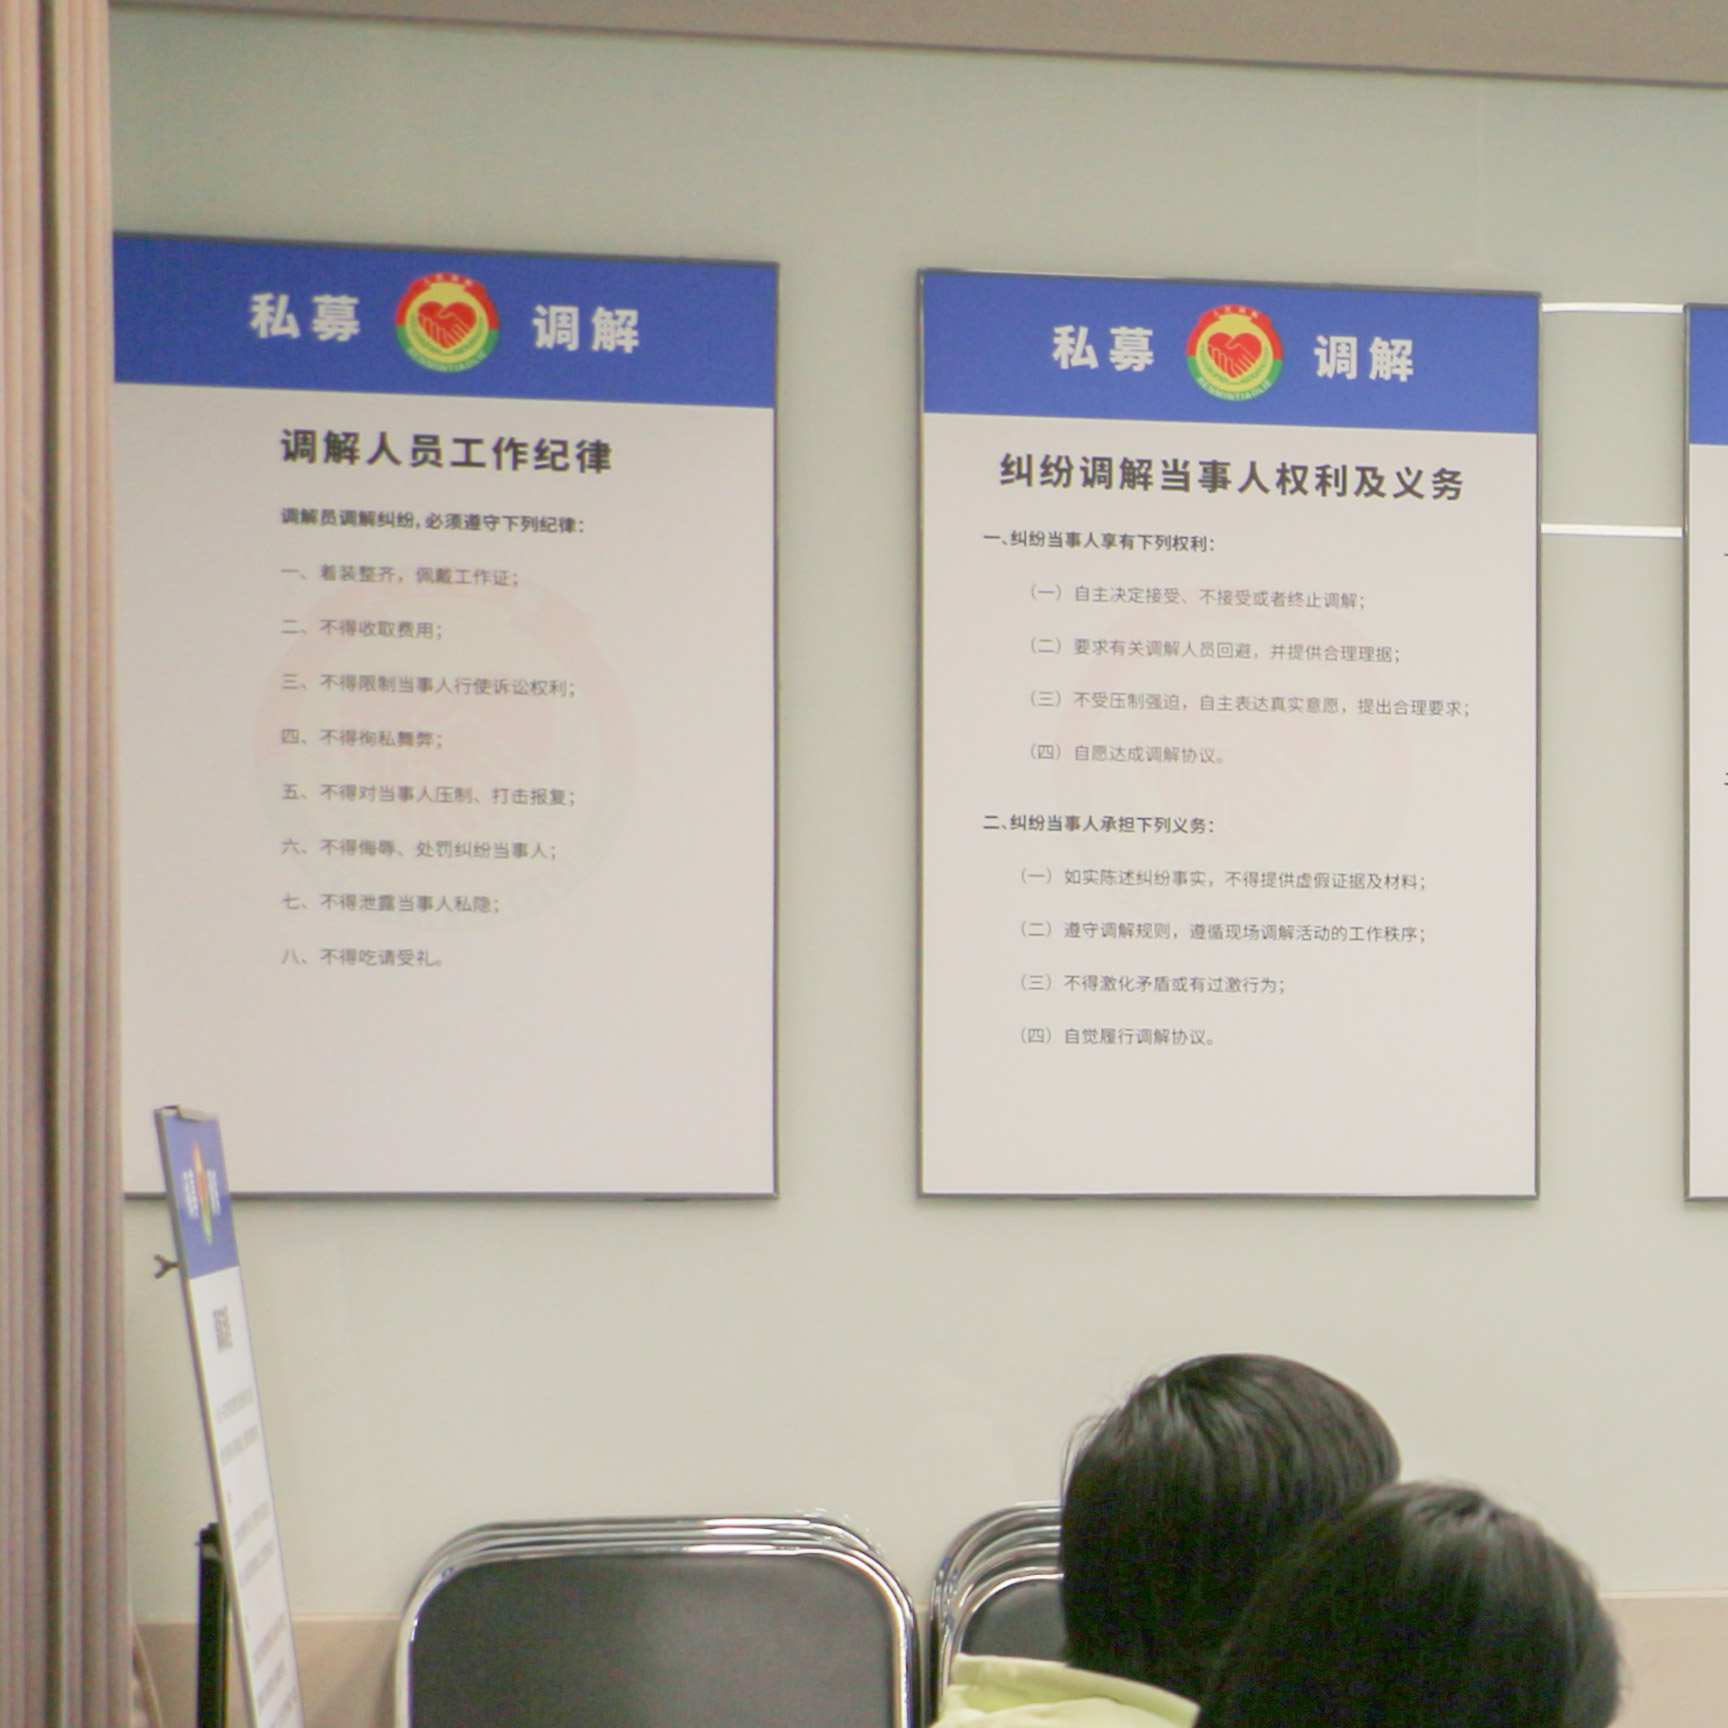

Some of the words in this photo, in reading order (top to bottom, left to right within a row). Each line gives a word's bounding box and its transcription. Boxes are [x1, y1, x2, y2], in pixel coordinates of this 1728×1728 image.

[249, 293, 361, 341] 私募
[532, 304, 641, 354] 调解
[1052, 326, 1155, 371] 私募
[1313, 336, 1414, 381] 调解
[281, 429, 611, 473] 调解人员工作纪律
[1000, 453, 1462, 500] 纠纷调解当事人权利及义务
